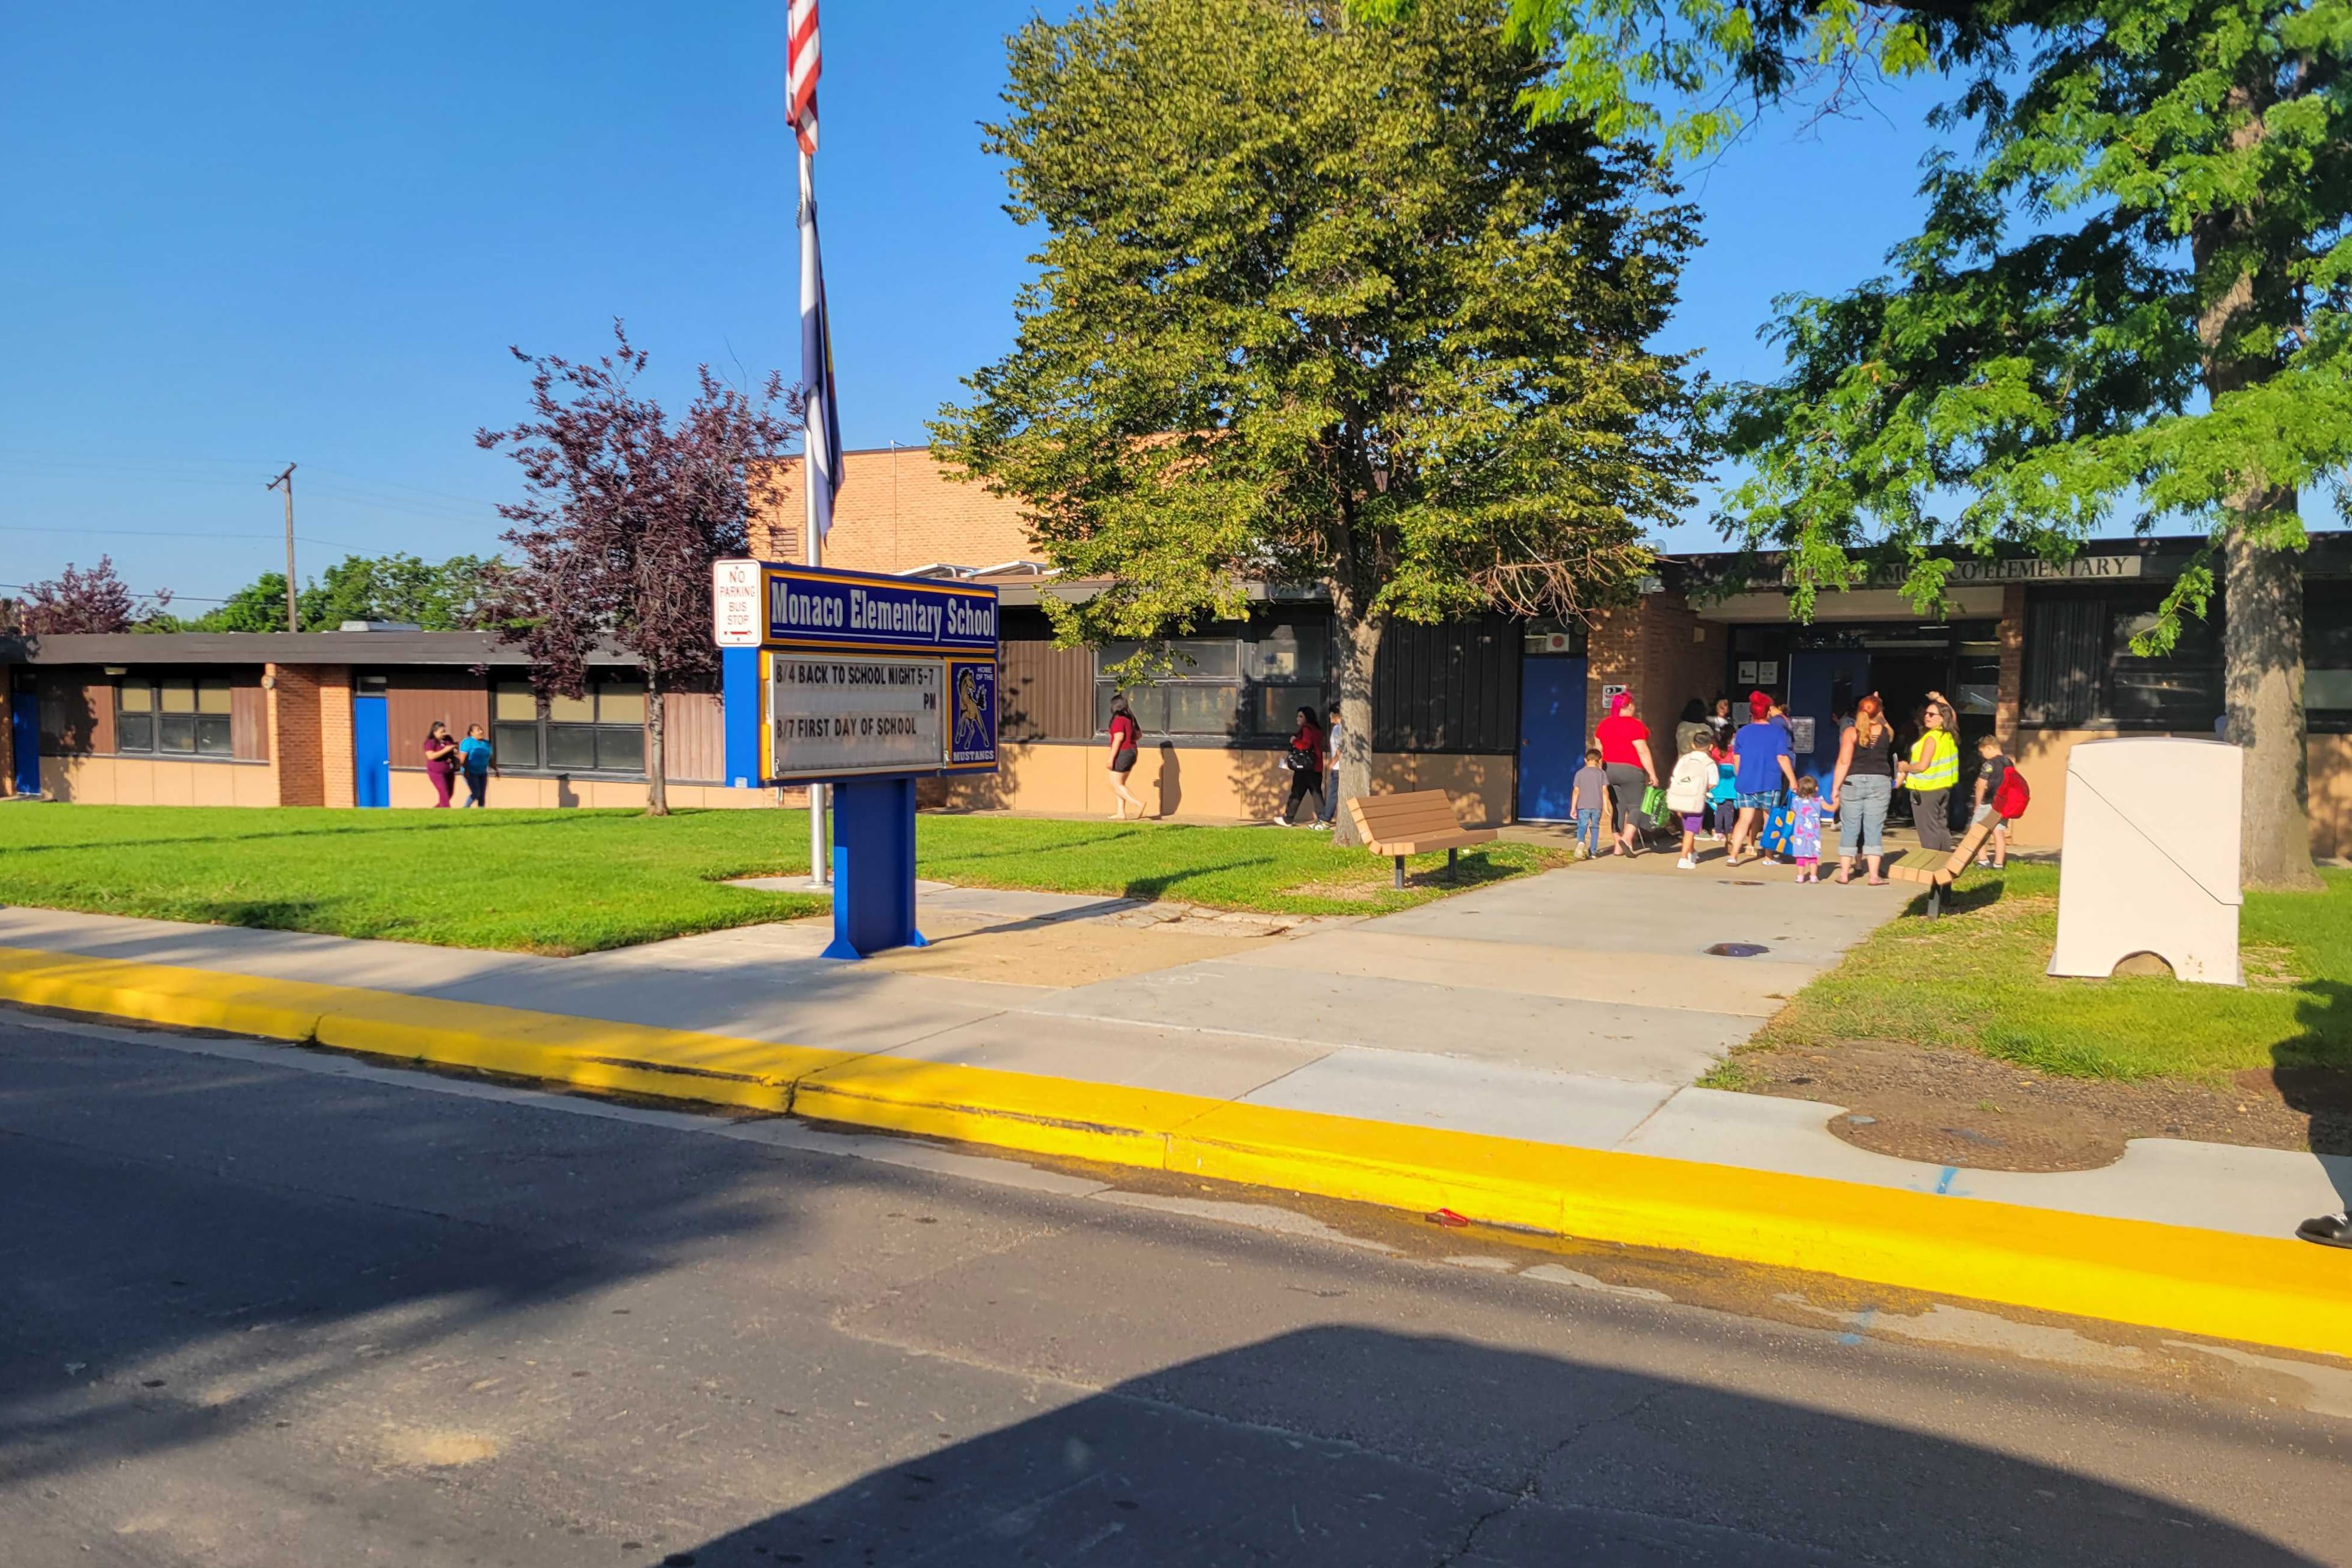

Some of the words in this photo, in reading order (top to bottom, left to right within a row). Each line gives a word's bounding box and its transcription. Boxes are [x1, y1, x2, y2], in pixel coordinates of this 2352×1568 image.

[729, 571, 746, 583] NO
[719, 586, 755, 597] PARKING
[729, 601, 747, 612] BUS
[771, 582, 843, 628] Monaco
[849, 589, 942, 642] Elementary
[947, 597, 995, 636] School
[727, 615, 749, 625] STOP
[776, 664, 795, 684] 8/4
[798, 665, 828, 684] BACK
[832, 666, 845, 684] TO
[848, 666, 886, 685] SCHOOL
[888, 666, 915, 685] NIGHT
[918, 667, 934, 685] 5-7
[923, 692, 936, 710] PM
[776, 719, 795, 738] 8/7
[797, 718, 830, 738] FIRST
[835, 718, 857, 736] DAY
[860, 718, 874, 736] OF
[877, 717, 917, 735] SCHOOL
[953, 750, 995, 761] MUSTANGS
